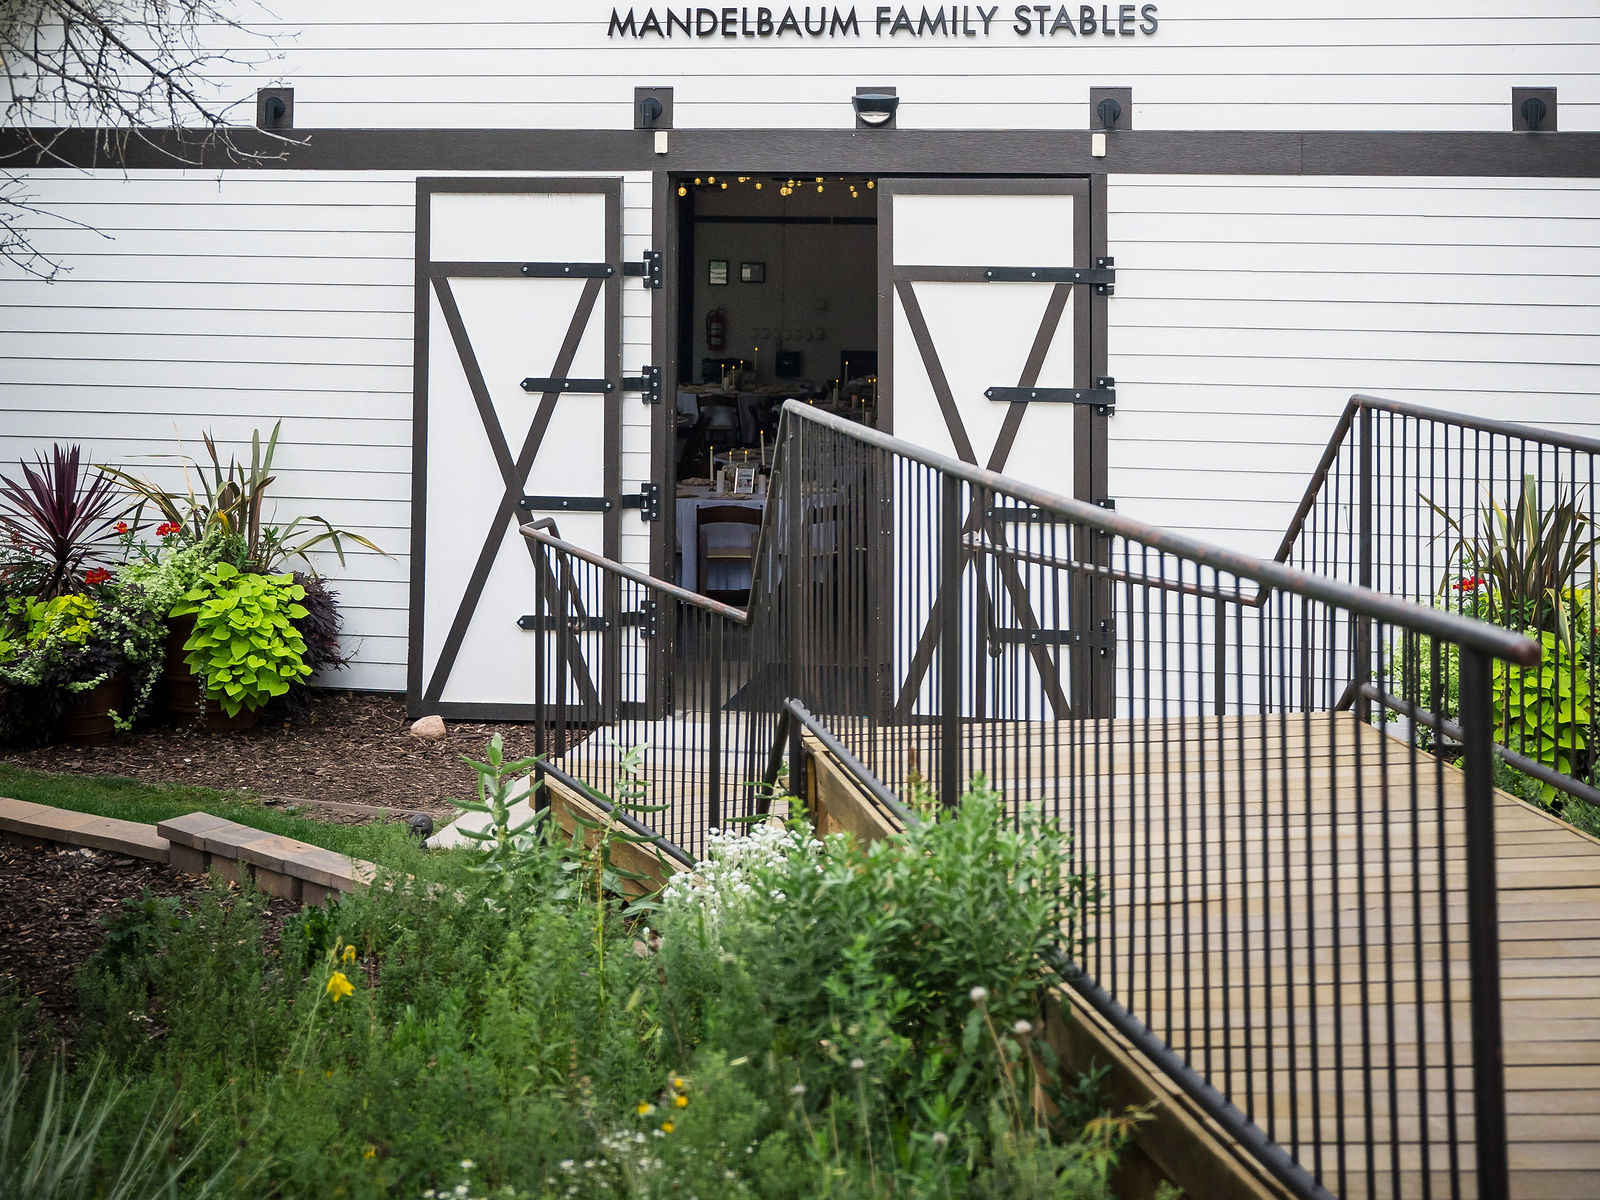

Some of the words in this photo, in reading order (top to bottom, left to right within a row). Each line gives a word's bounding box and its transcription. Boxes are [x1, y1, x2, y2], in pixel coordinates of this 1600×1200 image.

[607, 6, 861, 38] MANDELBAUM
[876, 5, 998, 37] FAMILY
[1013, 4, 1158, 36] STABLES
